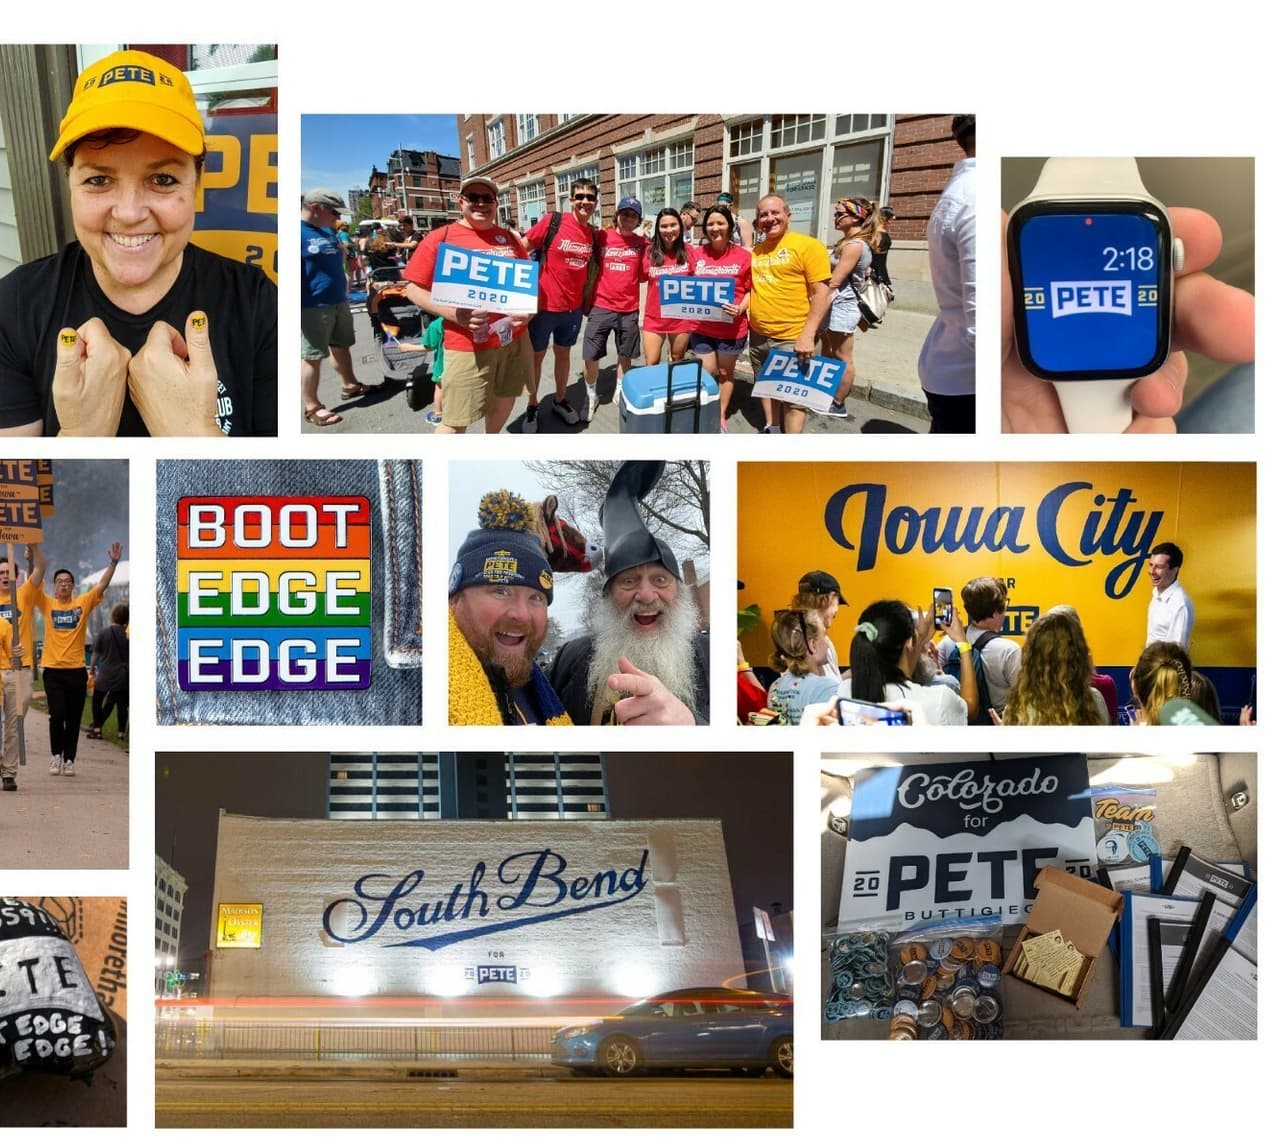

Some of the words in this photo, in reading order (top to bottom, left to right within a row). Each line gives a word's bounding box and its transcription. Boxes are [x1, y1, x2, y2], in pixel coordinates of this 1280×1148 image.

[102, 67, 153, 85] PETE
[442, 248, 533, 290] PETE
[1102, 246, 1155, 272] 2:18
[467, 289, 509, 304] 2020
[663, 279, 732, 305] PETE
[1024, 292, 1045, 305] 20
[1056, 285, 1127, 311] PETE
[1138, 290, 1158, 302] 20
[681, 306, 711, 316] 2020
[763, 354, 842, 389] PETE
[776, 384, 809, 398] 2020
[187, 503, 361, 550] BOOT
[824, 482, 1031, 573] Iowa
[1036, 480, 1165, 601] City
[485, 561, 515, 570] PETE
[187, 570, 362, 617] EDGE
[187, 638, 362, 685] EDGE
[897, 766, 1060, 813] Colorado
[964, 813, 989, 829] for
[1095, 798, 1155, 822] Team
[853, 876, 881, 891] 20
[886, 847, 1060, 911] PETE
[322, 859, 490, 945] South
[497, 847, 650, 910] Bend
[488, 951, 505, 959] FOR
[479, 967, 515, 982] PETE
[15, 1012, 84, 1036] EDGE
